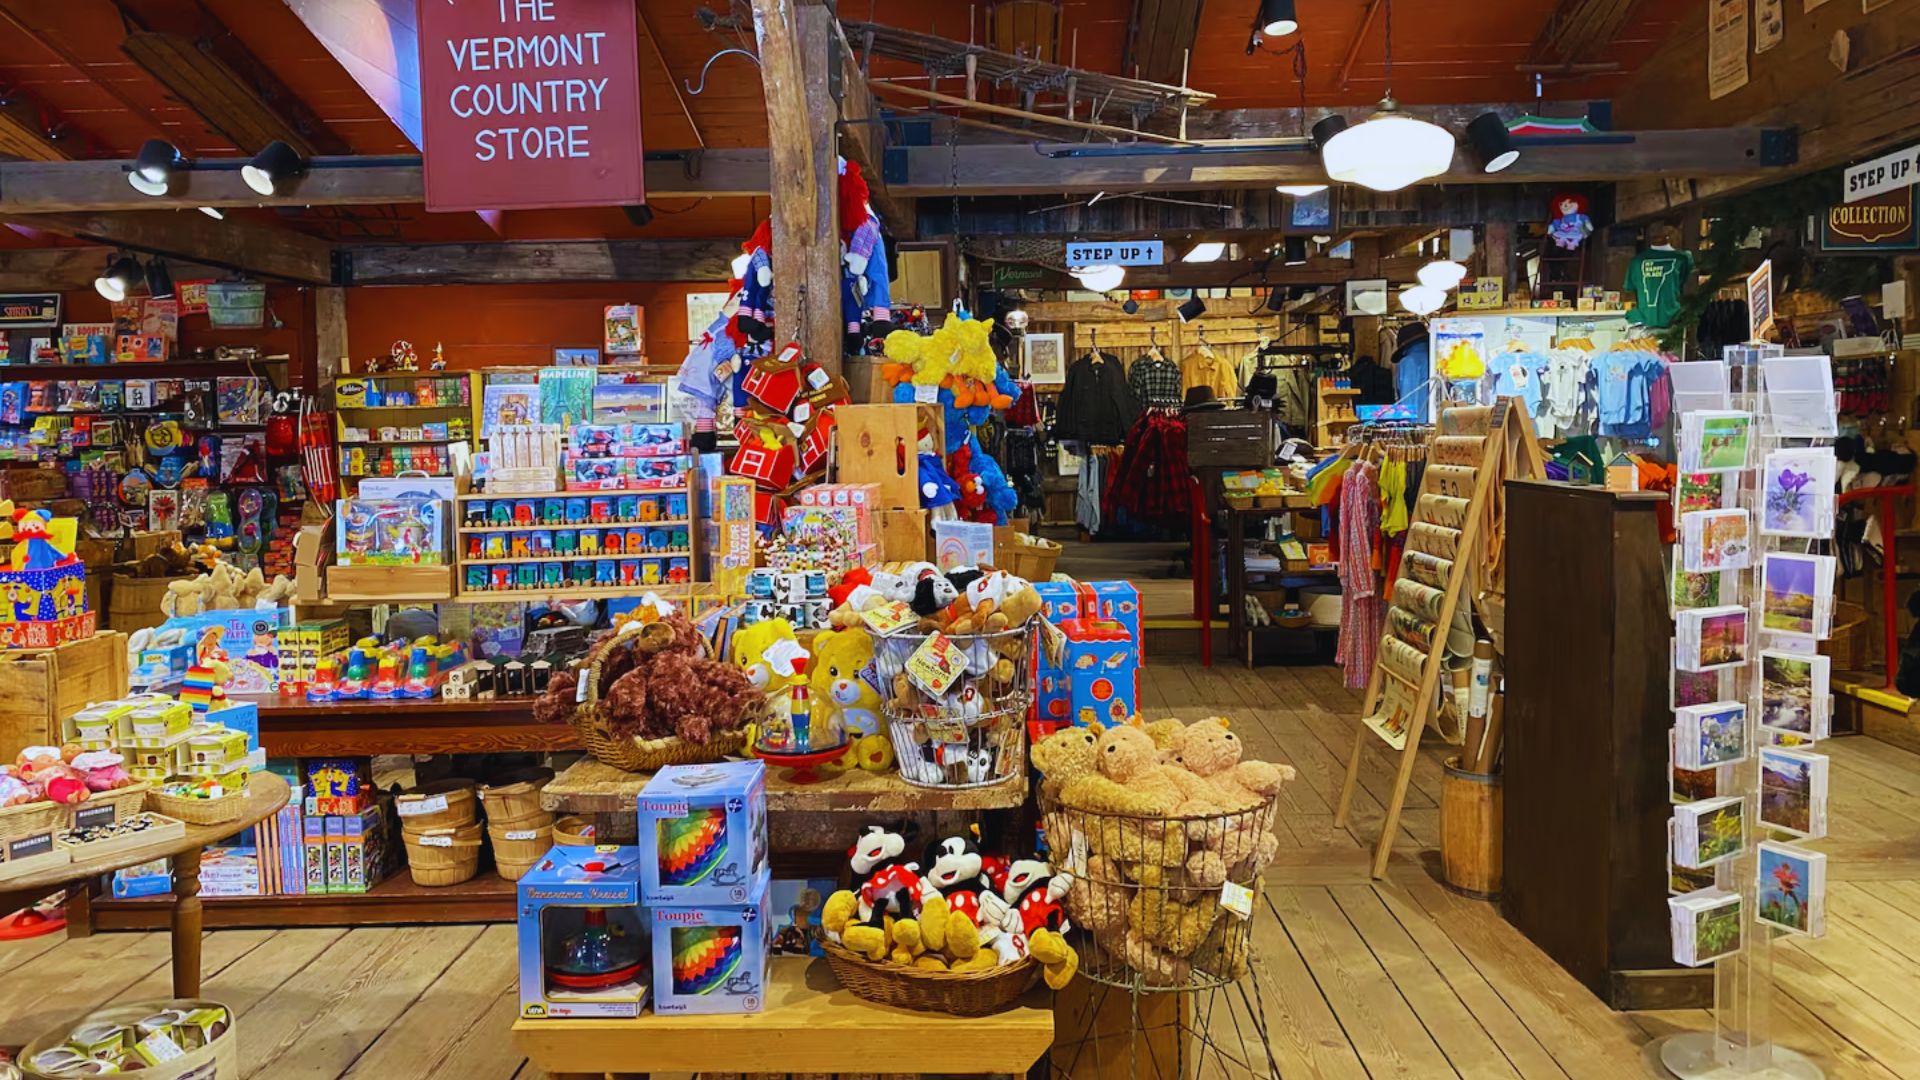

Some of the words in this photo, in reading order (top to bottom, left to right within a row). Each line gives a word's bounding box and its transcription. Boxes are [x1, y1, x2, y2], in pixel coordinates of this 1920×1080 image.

[499, 0, 556, 22] THE
[447, 32, 606, 72] VERMONT
[450, 77, 609, 118] COUNTRY
[475, 125, 590, 161] STORE
[1849, 166, 1885, 192] STEP
[1891, 158, 1911, 180] UP
[1832, 206, 1906, 225] COLLECTION
[1072, 248, 1113, 261] STEP
[1120, 248, 1140, 260] UP
[540, 369, 591, 379] MADELINE
[740, 523, 750, 566] PUZZLE
[229, 619, 246, 630] TEA
[226, 629, 250, 640] PARTY
[916, 657, 950, 682] Newborns
[643, 800, 689, 814] Toupie
[527, 887, 584, 899] Panorama
[657, 909, 704, 924] Toupie
